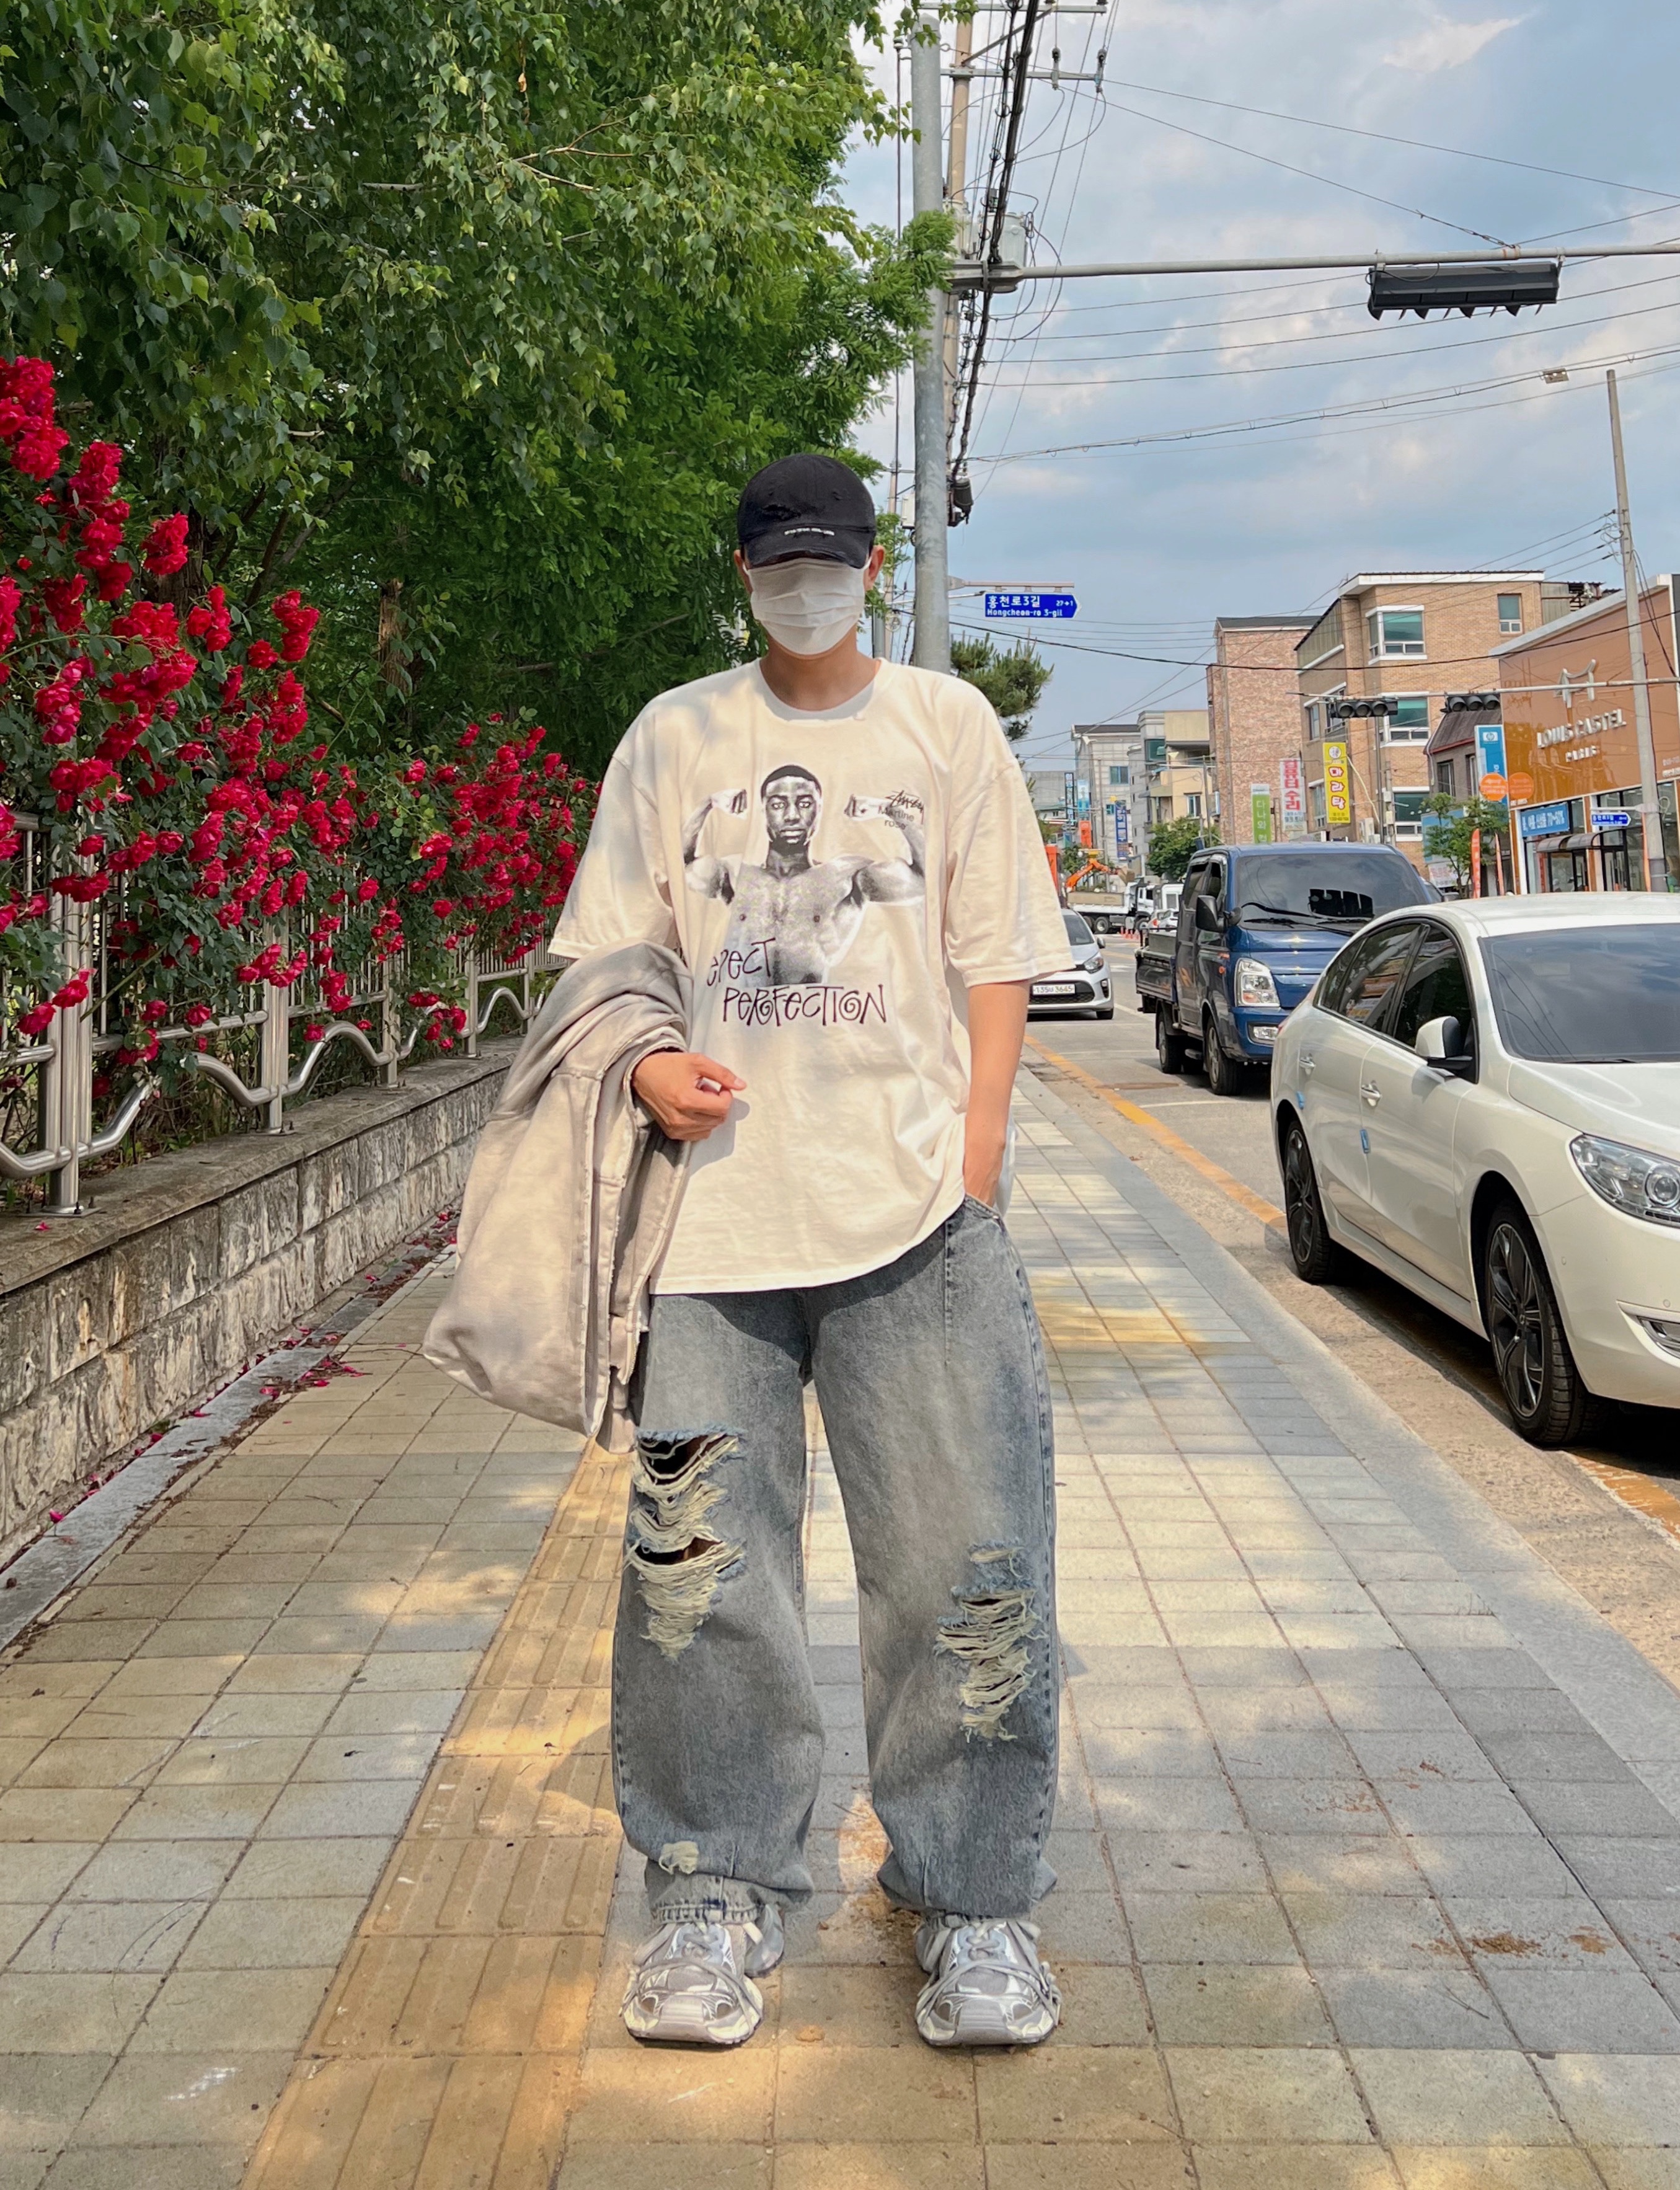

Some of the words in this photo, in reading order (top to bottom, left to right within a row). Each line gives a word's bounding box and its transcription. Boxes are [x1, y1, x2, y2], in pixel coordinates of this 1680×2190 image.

[987, 609, 1041, 617] Hongcheon-ro
[1044, 609, 1063, 618] 3-gil
[988, 595, 1040, 609] 홍천로3길
[1537, 723, 1573, 748] LOUIS
[1575, 708, 1627, 738] CASTEL
[1328, 766, 1346, 810] 마라탕
